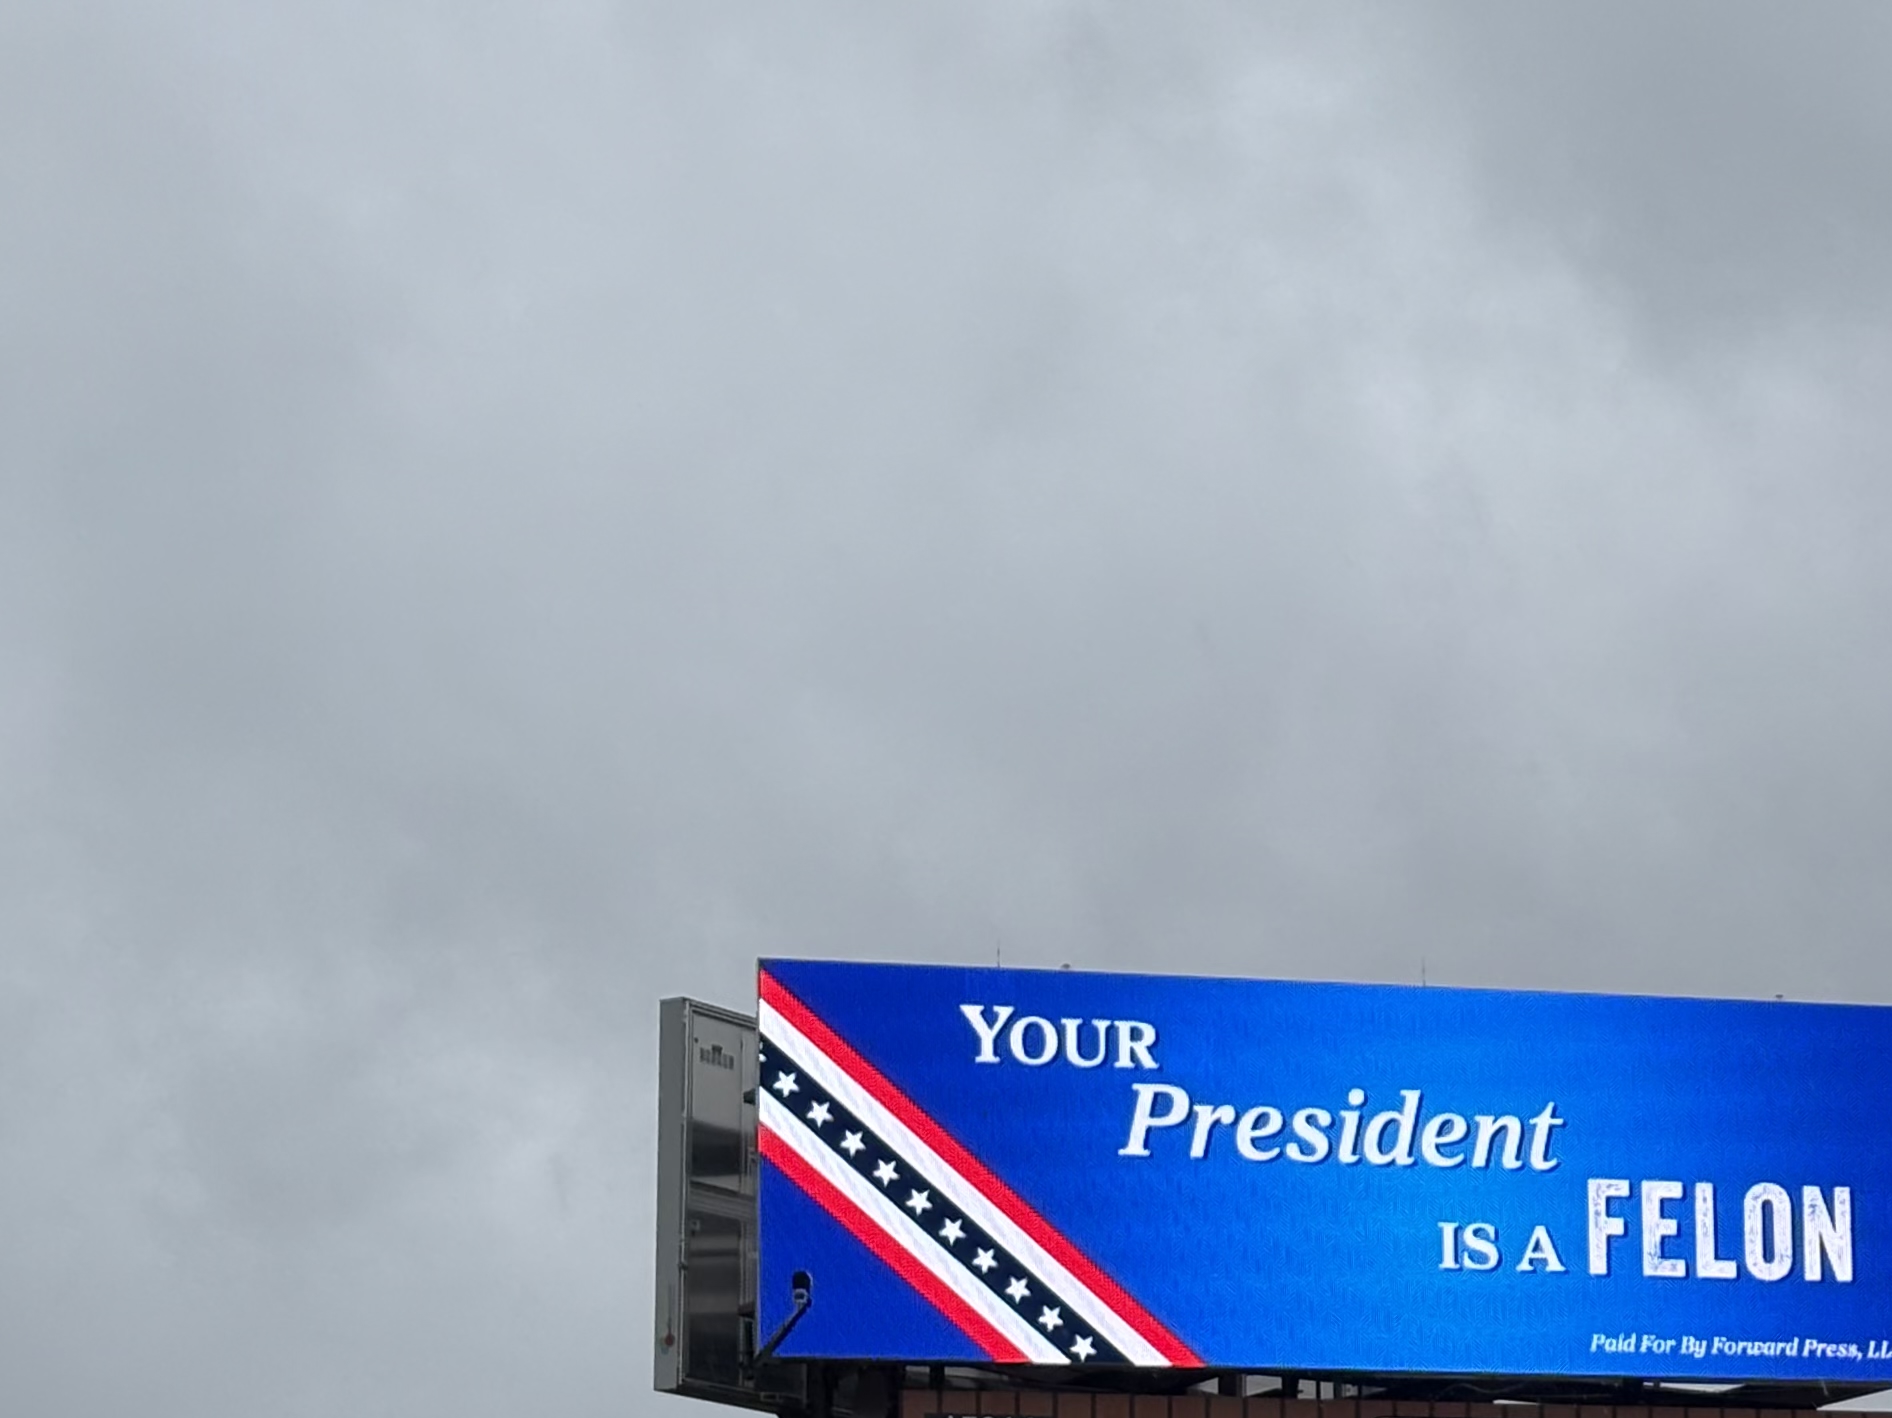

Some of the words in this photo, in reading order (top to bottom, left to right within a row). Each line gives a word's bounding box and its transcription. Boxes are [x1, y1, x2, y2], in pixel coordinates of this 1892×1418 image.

[959, 1004, 1160, 1069] YOUR
[1118, 1082, 1565, 1171] President
[1437, 1221, 1500, 1271] IS
[1515, 1225, 1566, 1272] A
[1587, 1178, 1853, 1282] FELON
[1591, 1333, 1637, 1353] Paid
[1639, 1334, 1676, 1354] For
[1681, 1335, 1708, 1359] By
[1710, 1336, 1799, 1357] Forward
[1802, 1338, 1864, 1361] Press,
